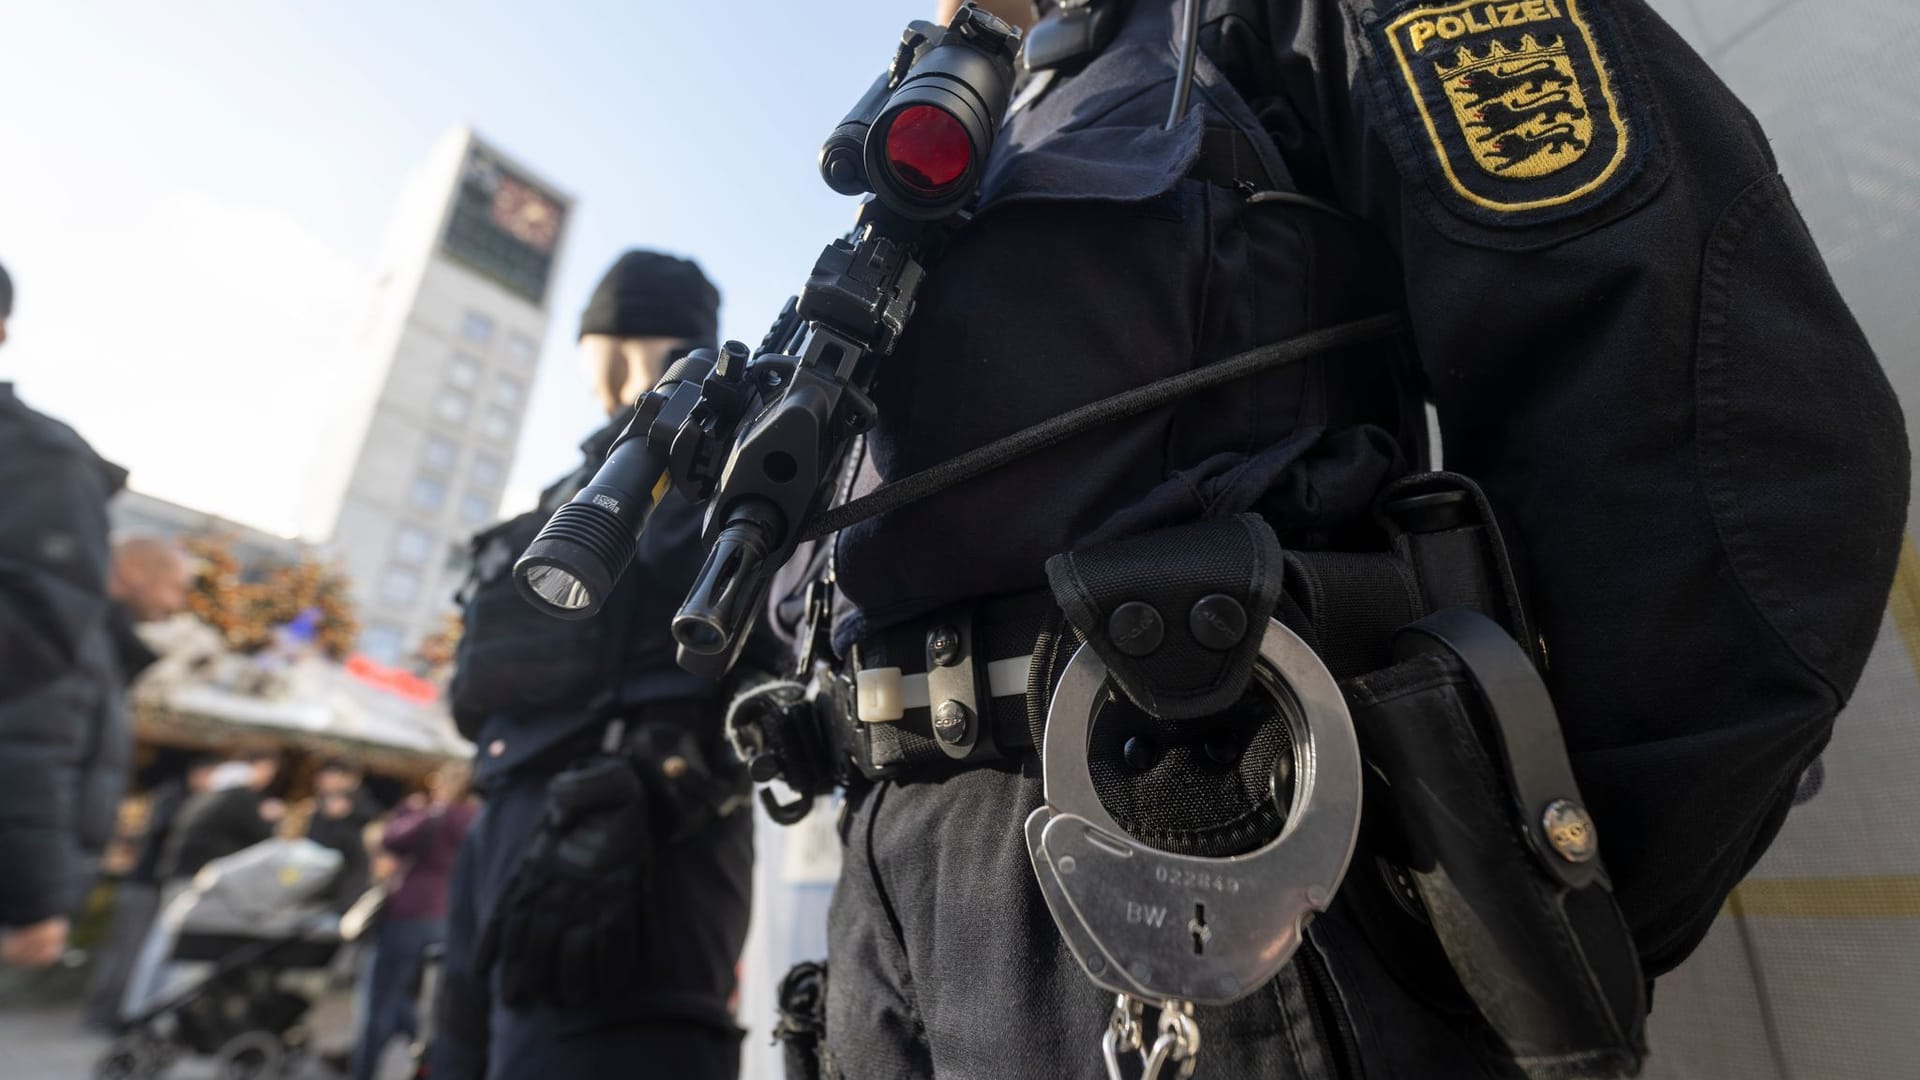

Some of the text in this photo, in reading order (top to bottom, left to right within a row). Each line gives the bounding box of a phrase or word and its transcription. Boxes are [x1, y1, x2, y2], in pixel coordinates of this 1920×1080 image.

[1408, 0, 1562, 52] POLIZEI
[935, 717, 962, 728] COP
[1126, 901, 1168, 929] BW
